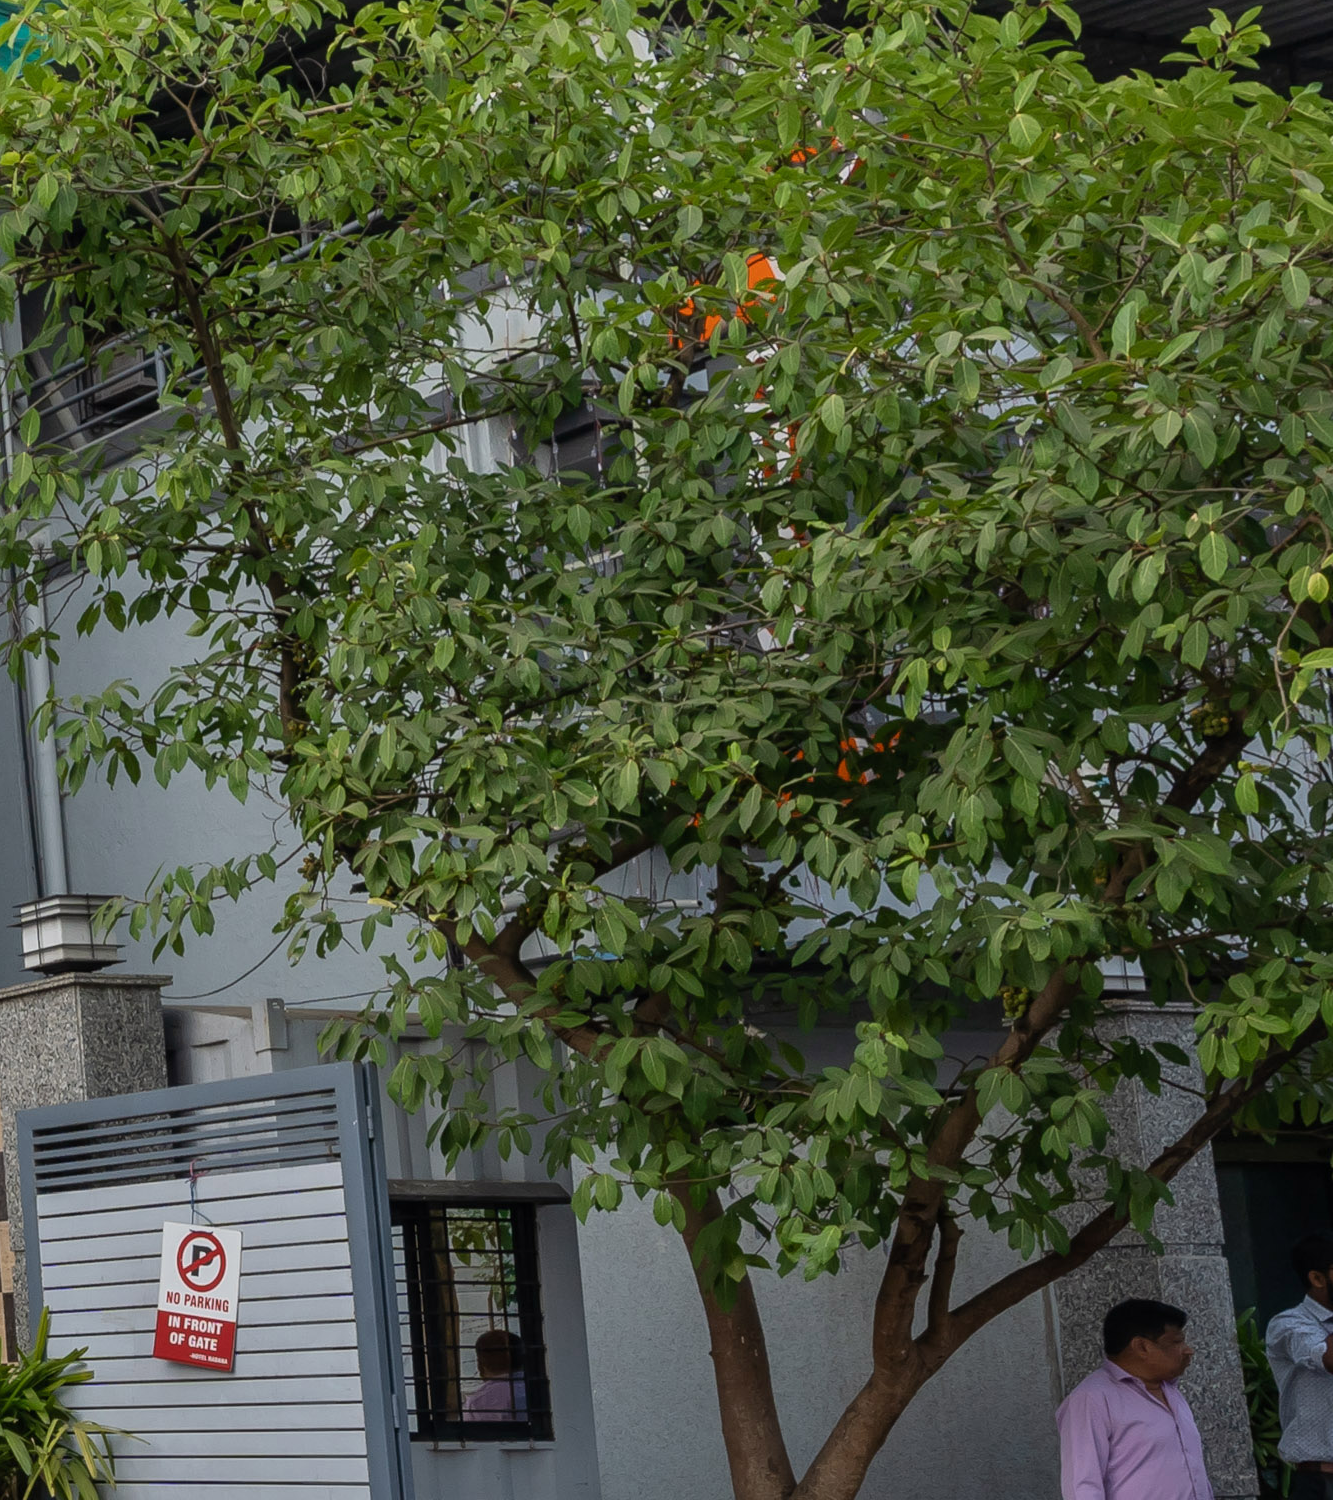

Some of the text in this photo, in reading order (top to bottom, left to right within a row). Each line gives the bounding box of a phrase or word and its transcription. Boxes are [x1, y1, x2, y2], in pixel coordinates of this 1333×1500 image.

[166, 1291, 229, 1313] NO PARKING
[168, 1315, 223, 1335] IN FRONT
[169, 1332, 218, 1351] OF GATE
